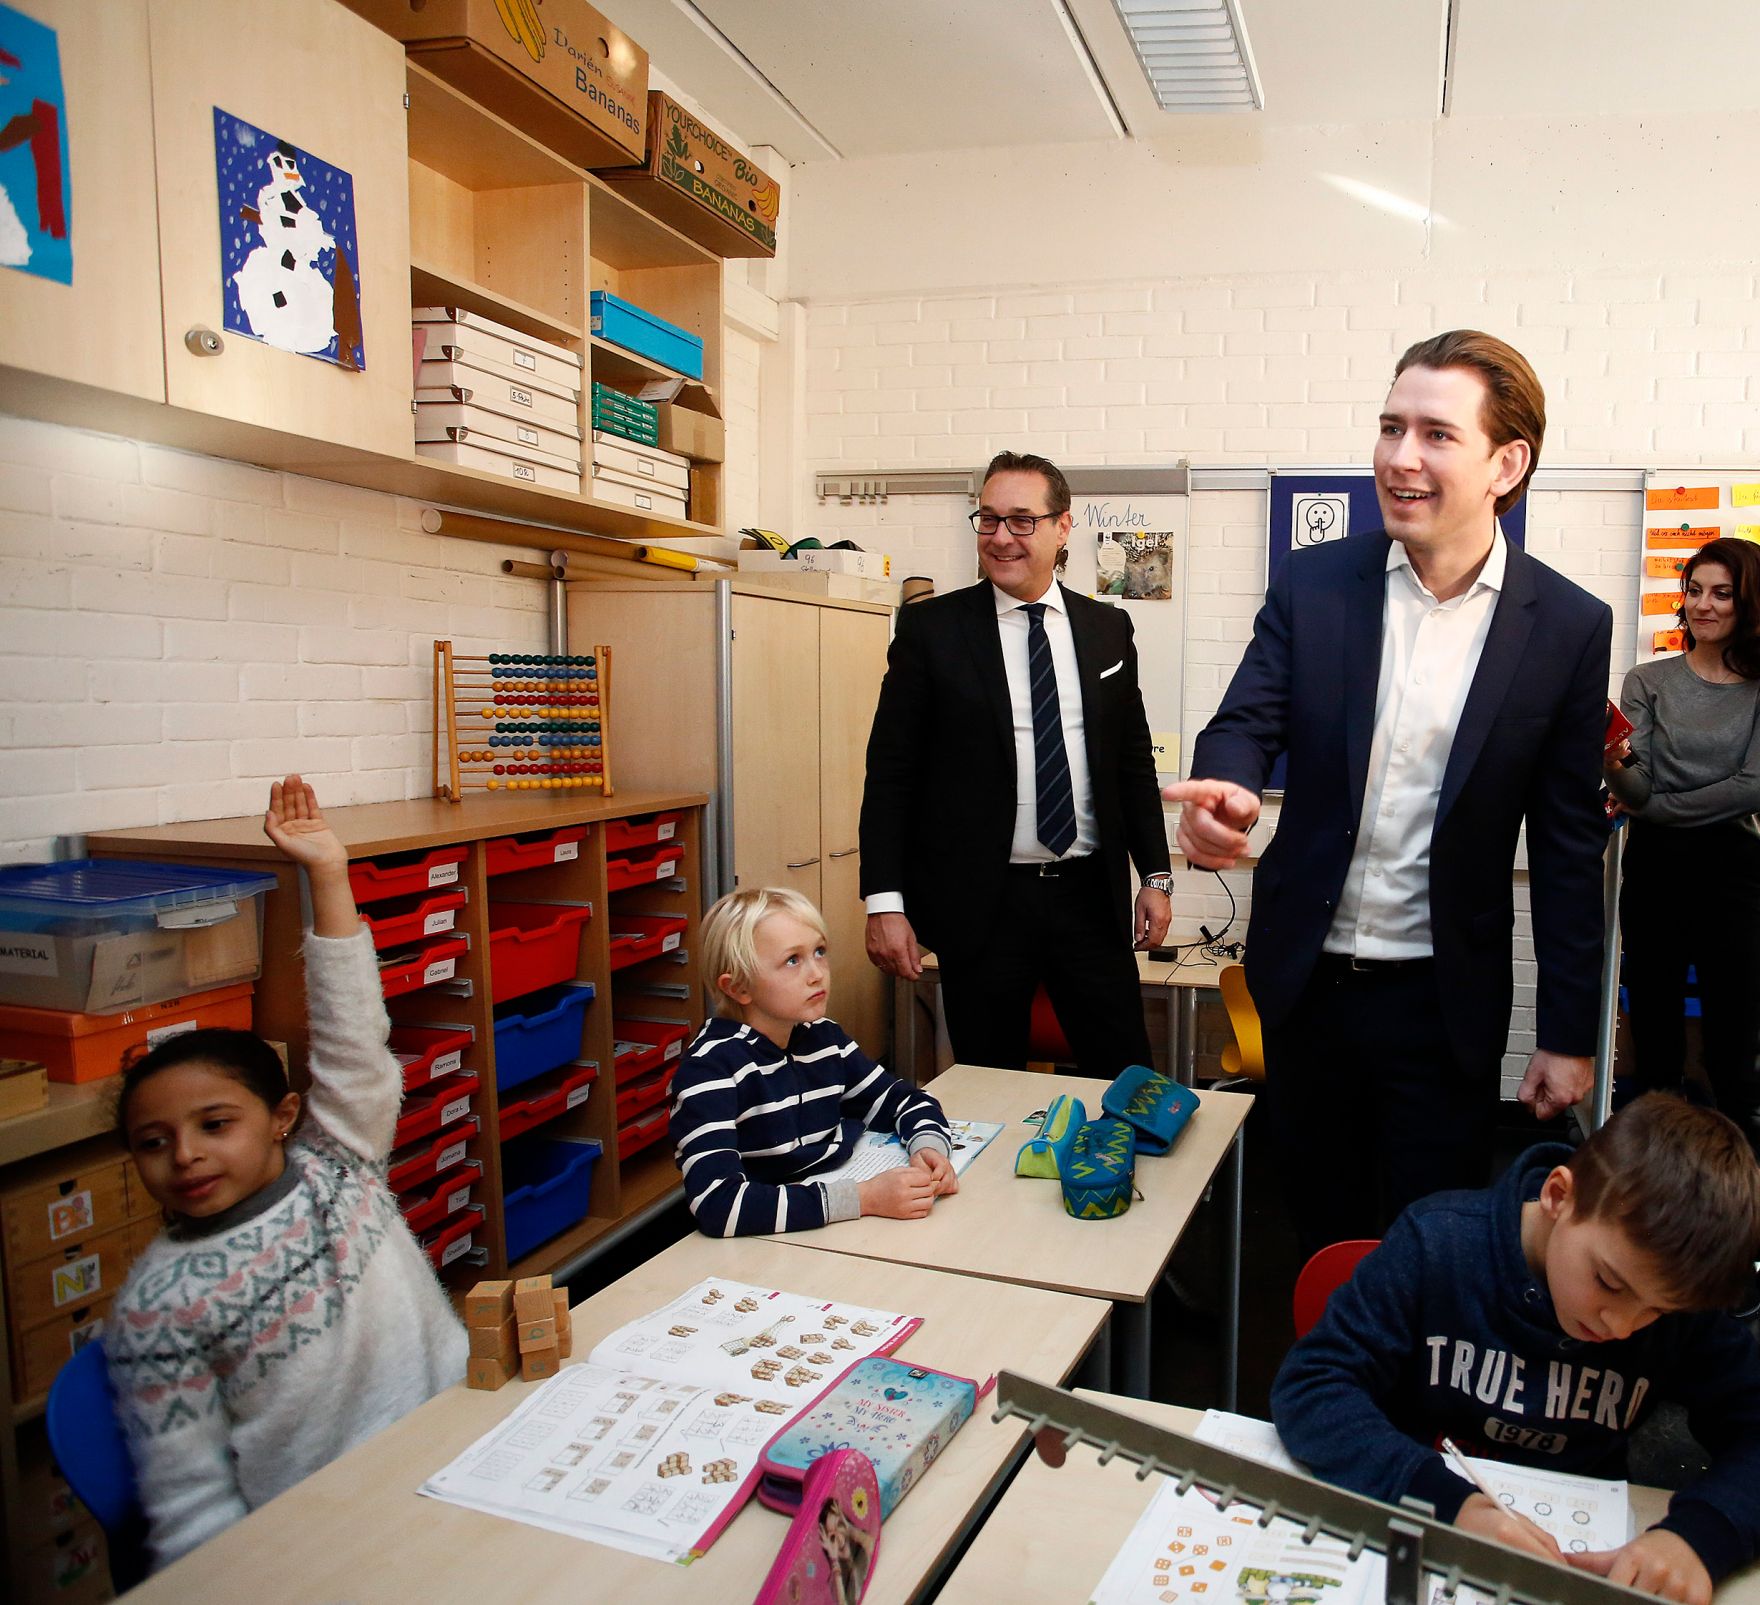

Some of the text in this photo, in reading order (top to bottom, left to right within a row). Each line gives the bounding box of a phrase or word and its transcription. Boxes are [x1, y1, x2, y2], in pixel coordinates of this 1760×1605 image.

[575, 65, 640, 135] Bananas
[733, 158, 758, 186] Bio
[693, 178, 755, 231] BANANAS
[1084, 502, 1151, 528] Winter
[430, 869, 457, 880] Alexander
[432, 919, 448, 927] Julian
[0, 946, 49, 961] MATERIAL
[430, 966, 449, 977] Gabriel
[434, 1059, 457, 1071] Ramona
[1426, 1335, 1526, 1415] TRUE
[1493, 1420, 1558, 1451] 1978
